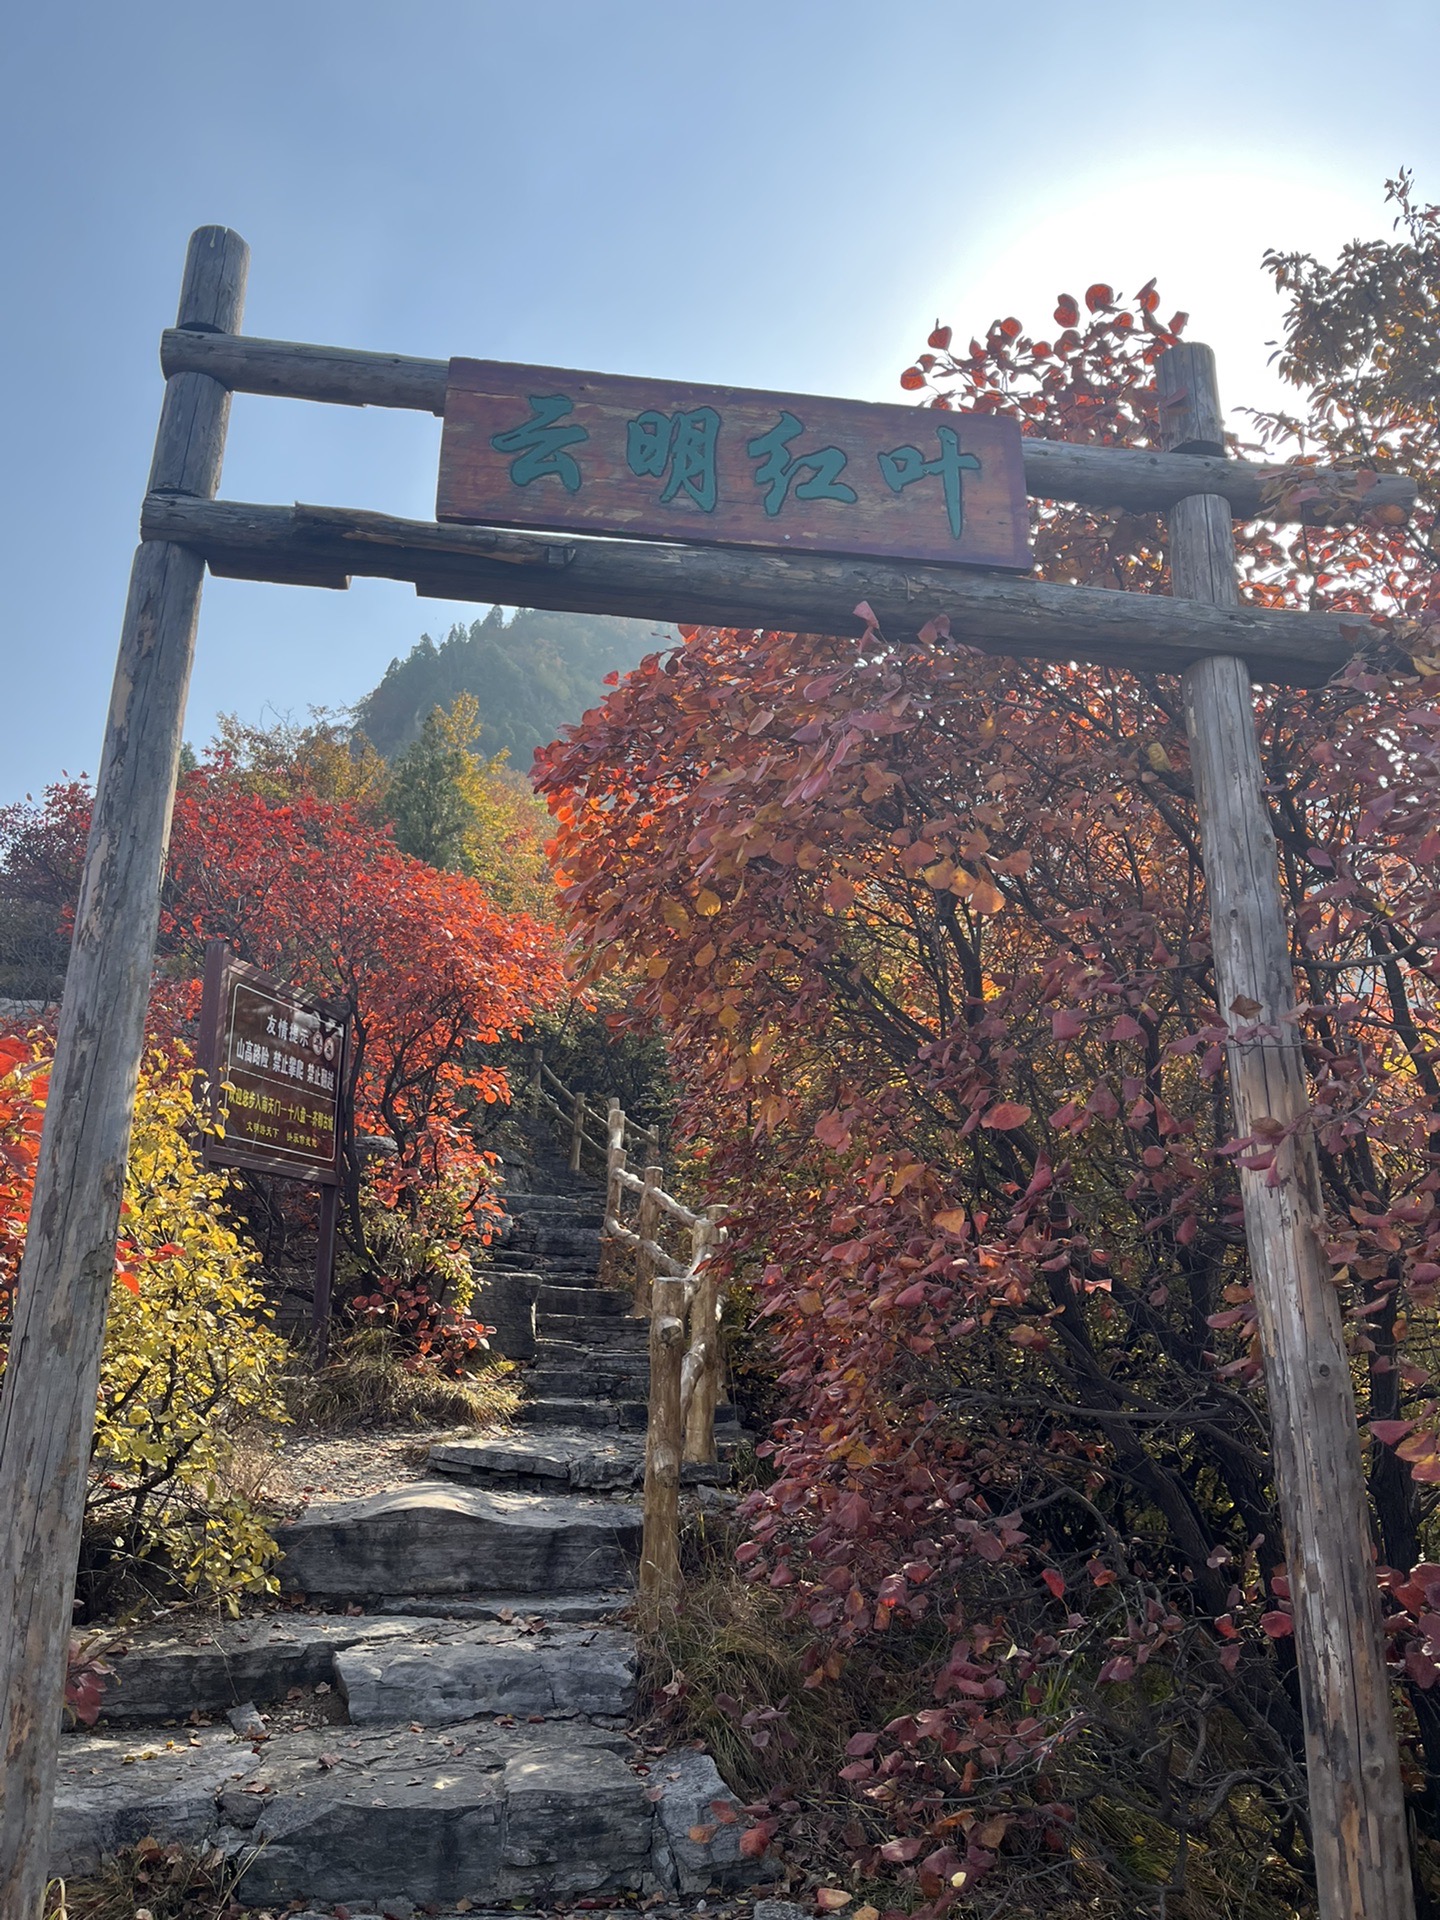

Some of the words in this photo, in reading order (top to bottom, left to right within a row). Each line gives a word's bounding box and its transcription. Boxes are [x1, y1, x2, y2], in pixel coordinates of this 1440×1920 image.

[490, 394, 982, 540] 云明红叶
[266, 1014, 309, 1047] 友情提示
[236, 1037, 270, 1068] 山高路险
